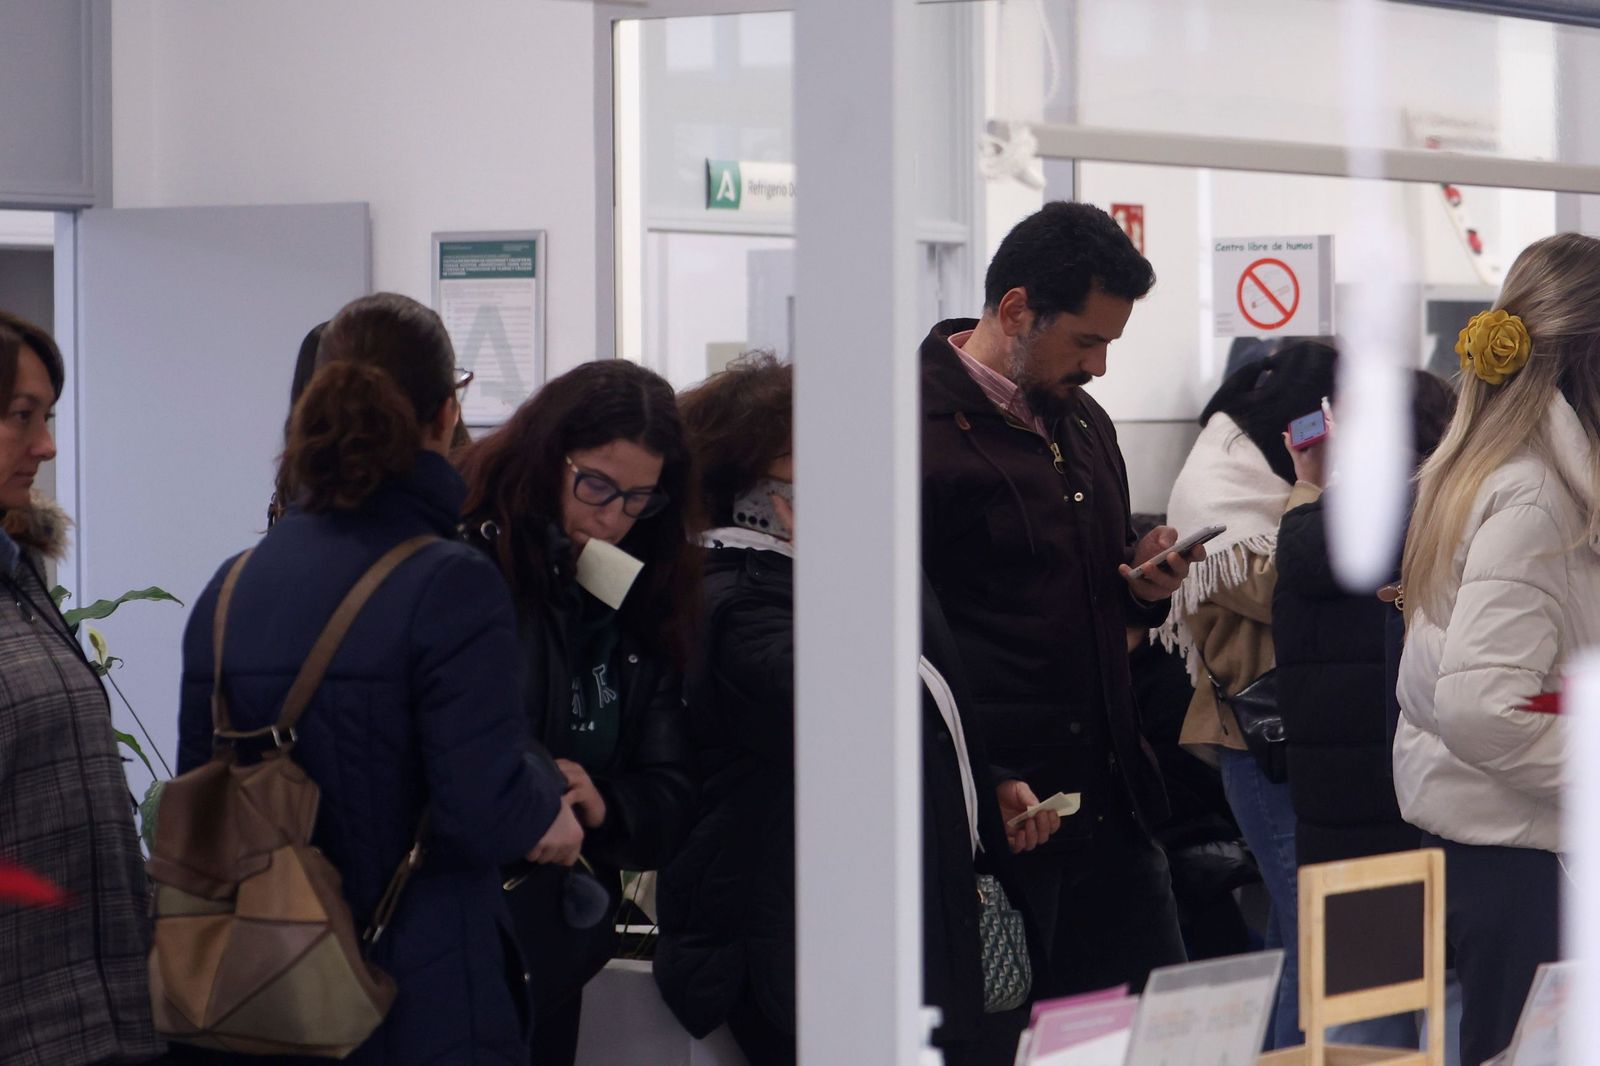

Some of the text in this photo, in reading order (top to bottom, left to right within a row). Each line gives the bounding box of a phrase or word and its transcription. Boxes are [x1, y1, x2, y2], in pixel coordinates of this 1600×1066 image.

[1215, 241, 1313, 252] Centro libre de humos
